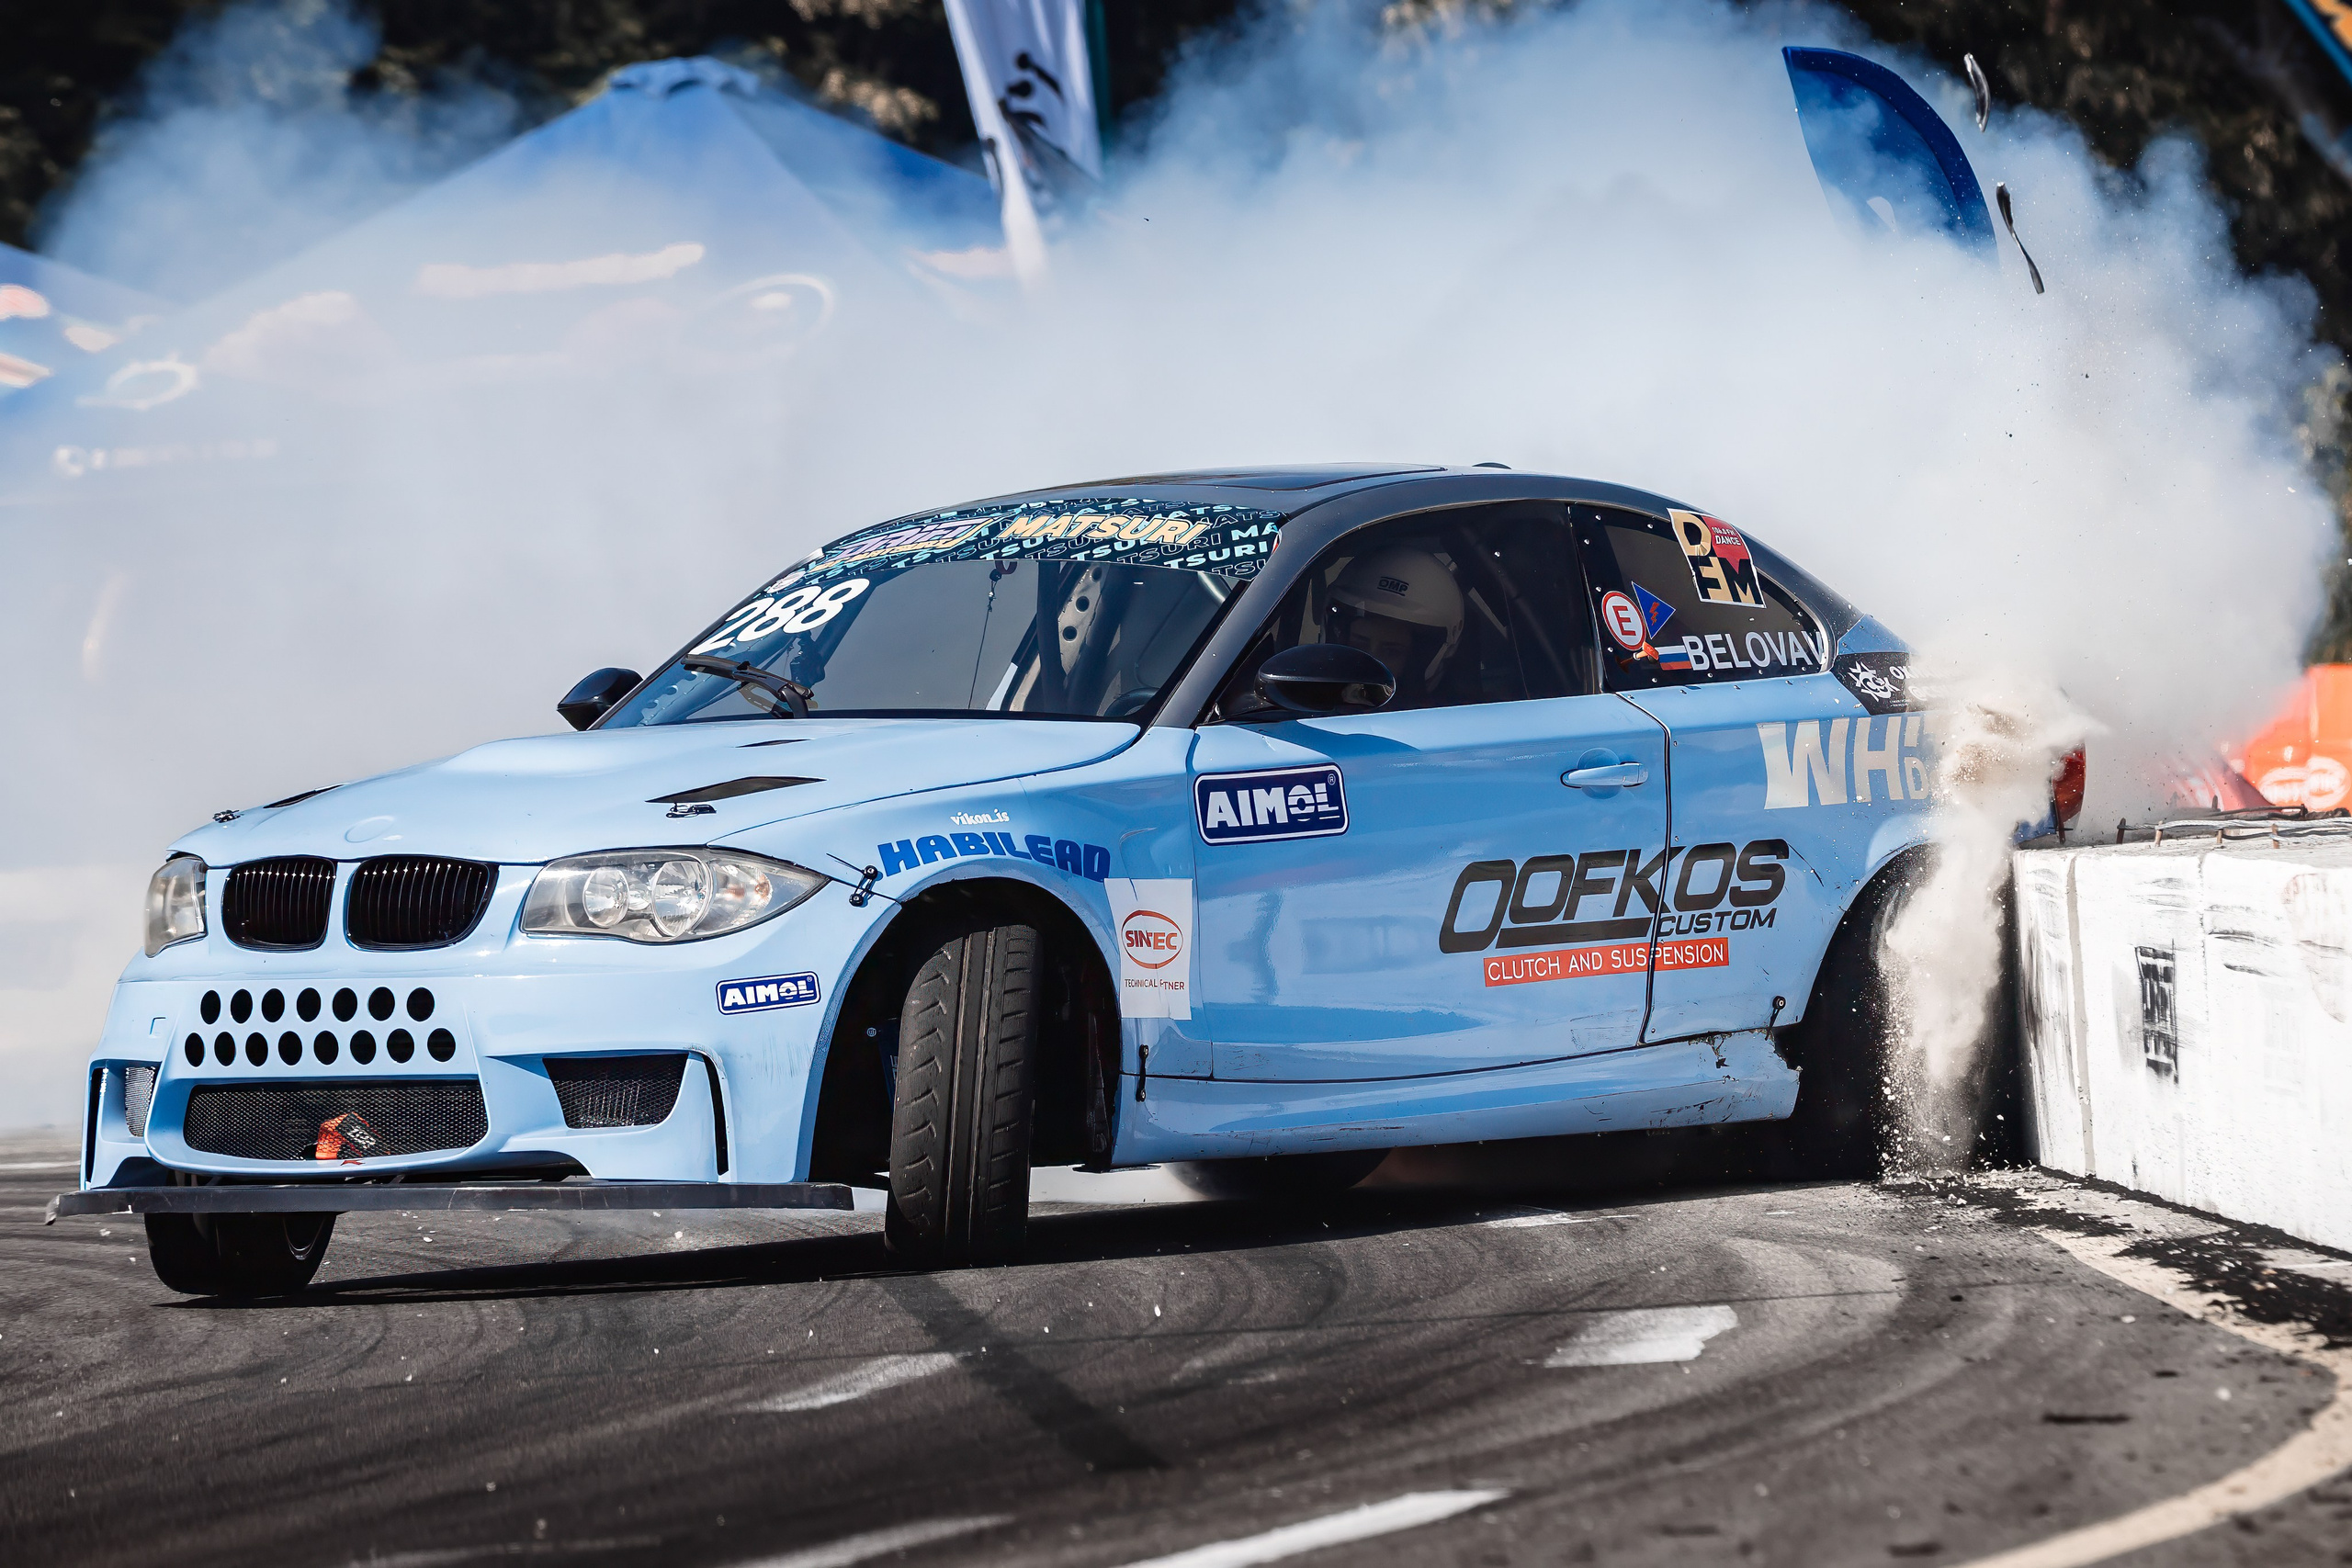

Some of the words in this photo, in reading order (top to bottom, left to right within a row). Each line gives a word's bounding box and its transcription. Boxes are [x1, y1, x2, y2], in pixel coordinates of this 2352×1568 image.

[998, 513, 1213, 545] MATSURI
[1714, 535, 1742, 546] DANCE
[1378, 578, 1408, 593] OMP
[687, 578, 870, 655] 288
[1612, 605, 1636, 637] E
[1205, 782, 1340, 829] AIMOL
[877, 832, 1111, 883] HABILEAD
[1656, 908, 1778, 938] CUSTOM
[1487, 954, 1560, 982] CLUTCH
[1568, 951, 1603, 974] AND
[1611, 943, 1724, 969] SUSPENSION
[723, 979, 815, 1008] AIMOL
[1125, 978, 1158, 988] TECHNICAL
